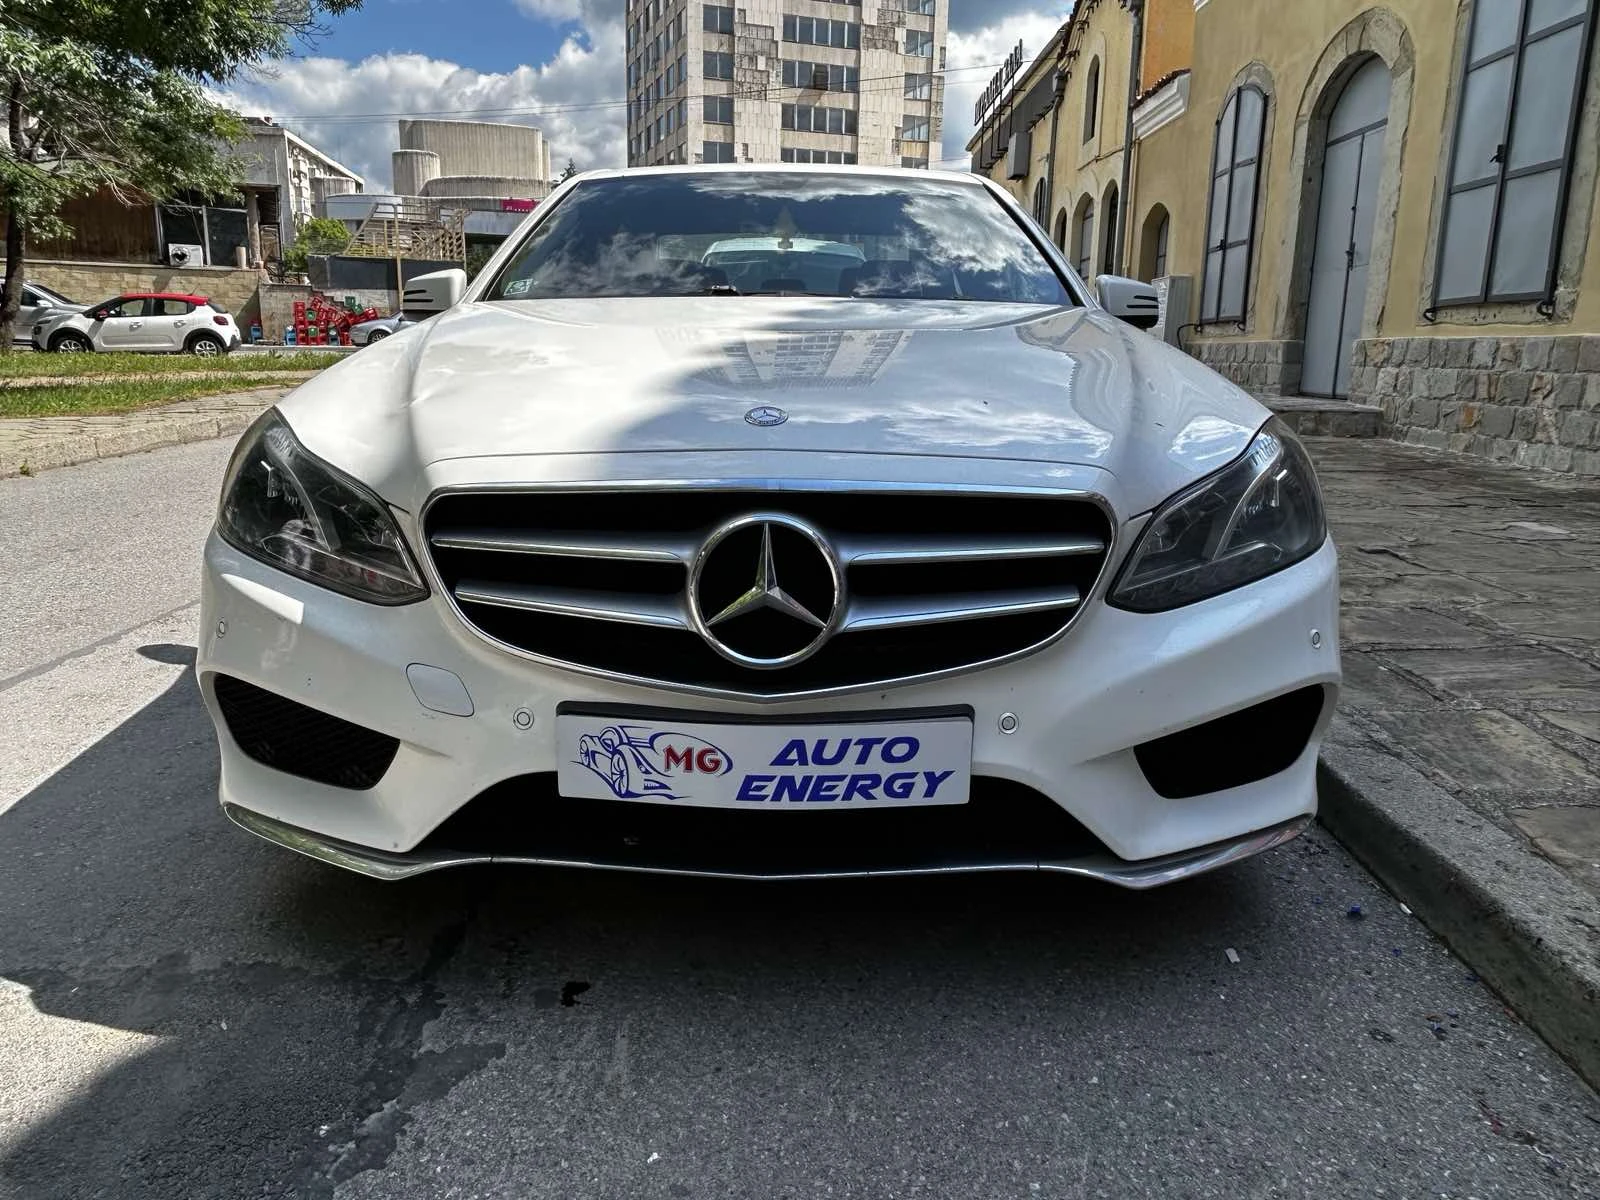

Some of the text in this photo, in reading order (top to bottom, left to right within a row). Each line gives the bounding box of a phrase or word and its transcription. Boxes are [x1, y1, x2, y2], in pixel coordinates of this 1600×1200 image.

[664, 744, 722, 775] MG
[769, 736, 920, 767] AUTO
[736, 770, 955, 802] ENERGY
